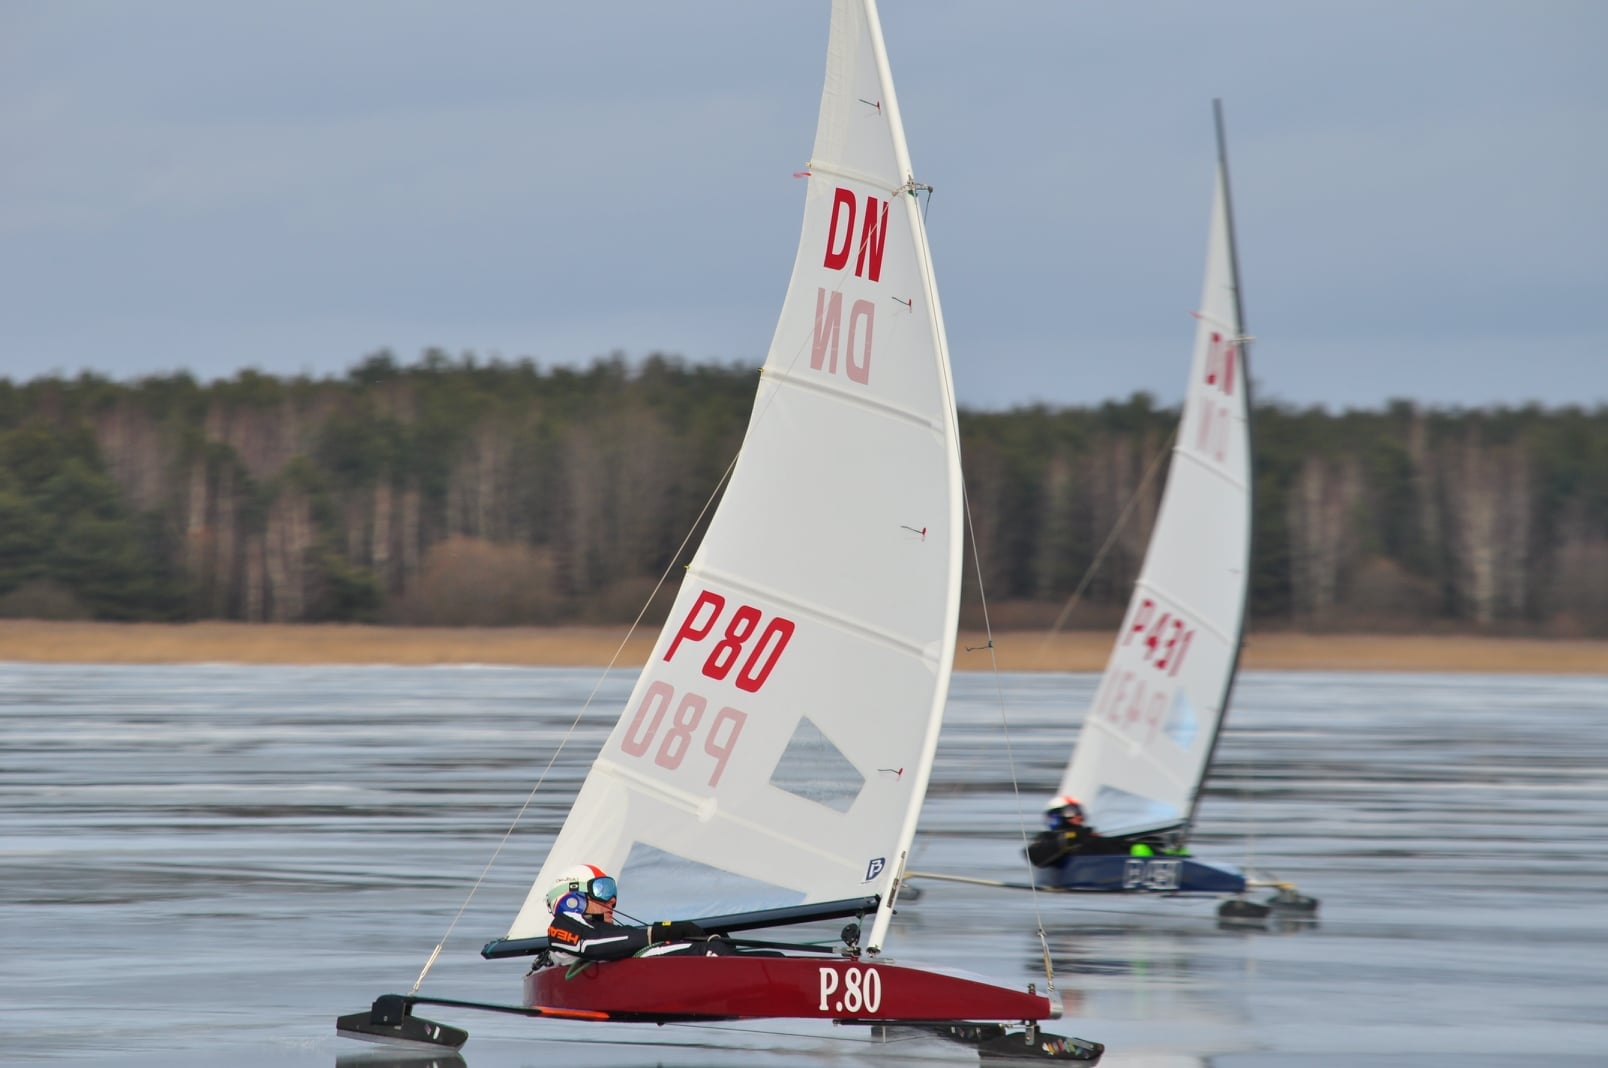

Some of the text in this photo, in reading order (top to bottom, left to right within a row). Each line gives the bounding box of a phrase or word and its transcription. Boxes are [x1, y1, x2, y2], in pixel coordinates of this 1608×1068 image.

[824, 187, 889, 282] DN
[663, 590, 795, 693] P80
[1122, 598, 1195, 677] P431
[548, 926, 580, 945] HEA
[819, 967, 882, 1013] P.80
